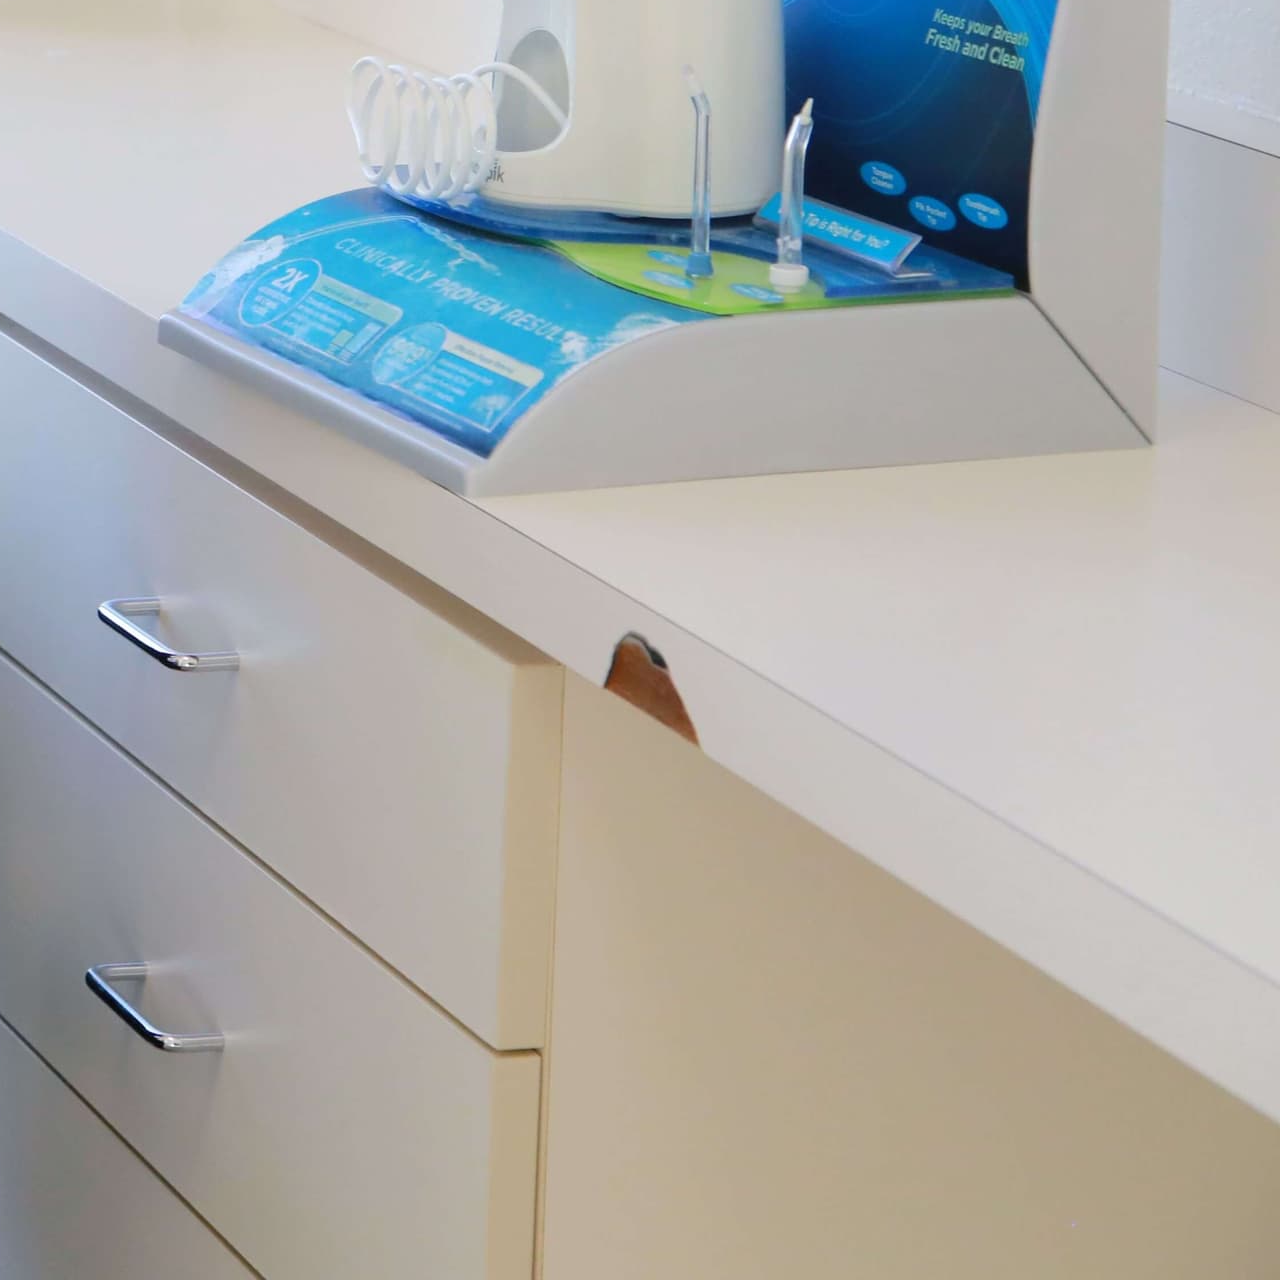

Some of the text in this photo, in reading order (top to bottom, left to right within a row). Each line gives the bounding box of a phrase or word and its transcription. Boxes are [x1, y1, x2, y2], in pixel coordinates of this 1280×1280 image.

[932, 8, 1030, 48] Keeps your Breath
[925, 28, 1026, 72] Fresh and Clean
[272, 267, 309, 294] 2X
[335, 237, 437, 284] CLINICALLY
[427, 277, 511, 317] PROVEN
